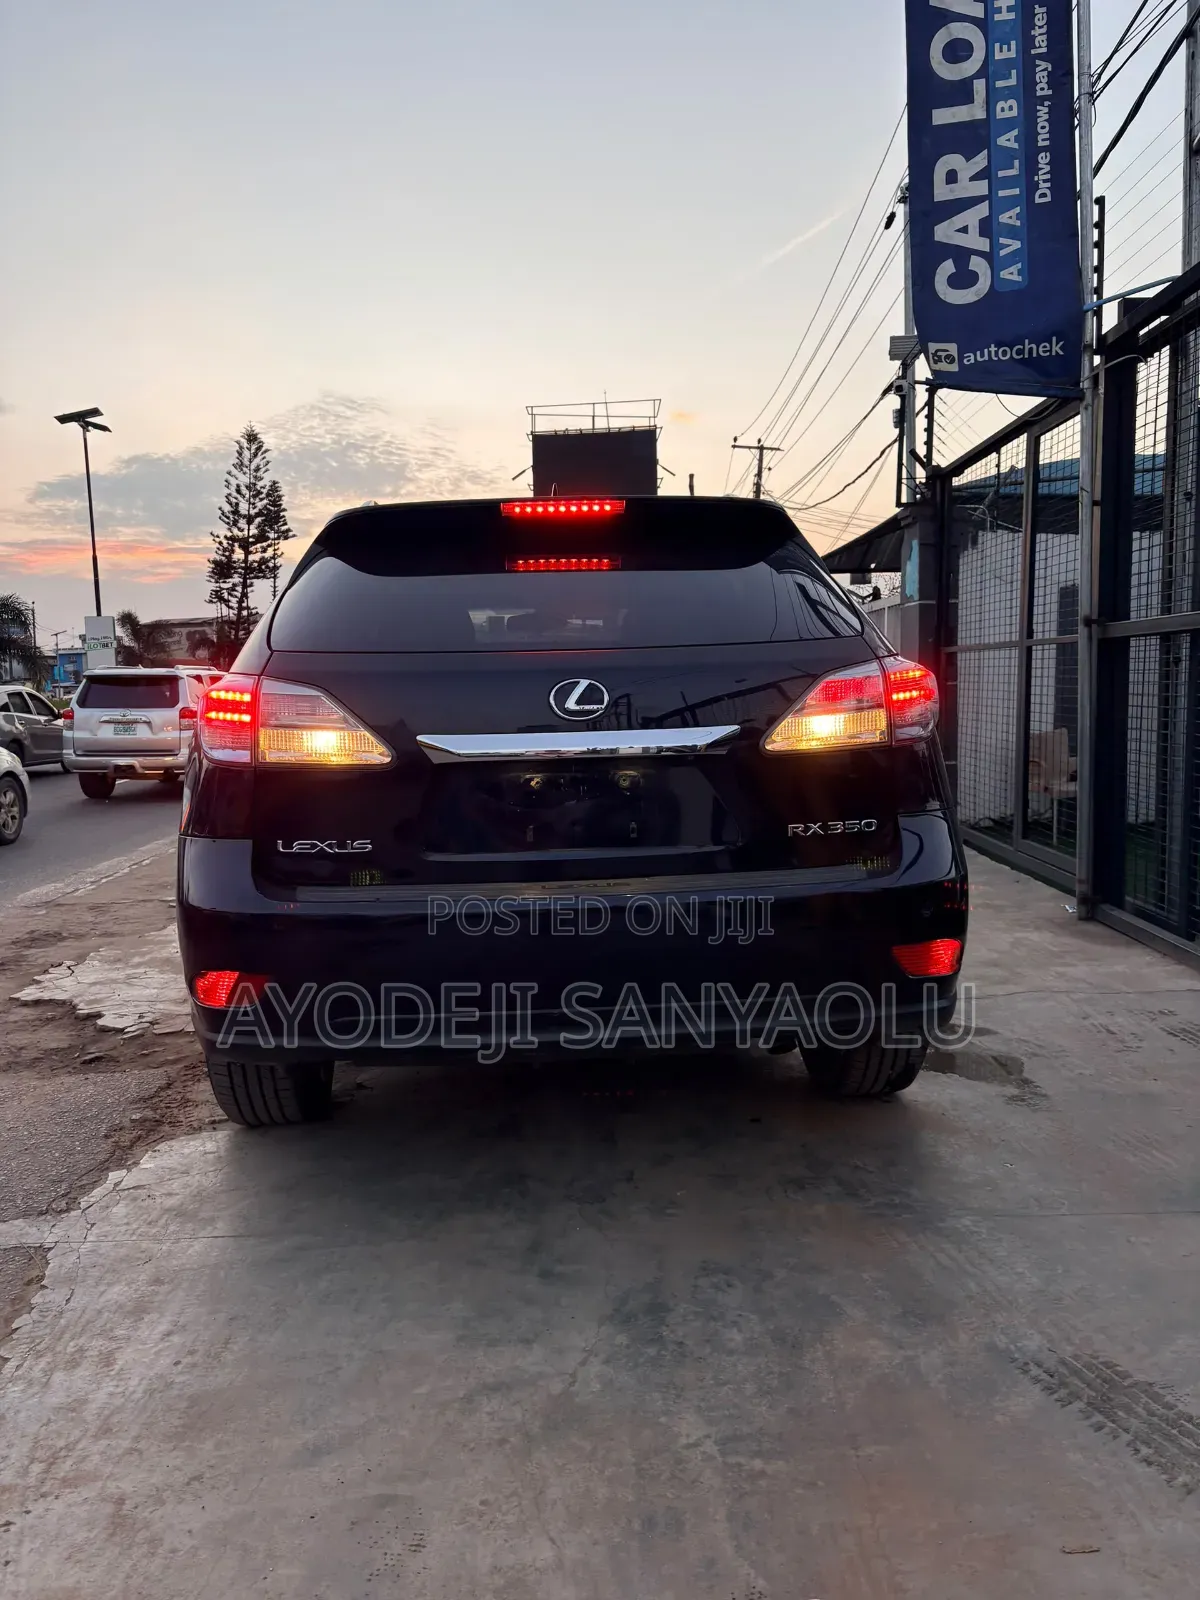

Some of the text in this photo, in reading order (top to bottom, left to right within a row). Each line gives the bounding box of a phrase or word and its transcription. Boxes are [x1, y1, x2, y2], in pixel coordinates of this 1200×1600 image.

[1030, 4, 1053, 204] Drive now, pay later
[994, 40, 1023, 282] AVAILABLE
[934, 149, 992, 304] CAR
[963, 336, 1065, 365] autochek
[276, 840, 373, 853] LEXUS
[787, 819, 878, 837] RX 350
